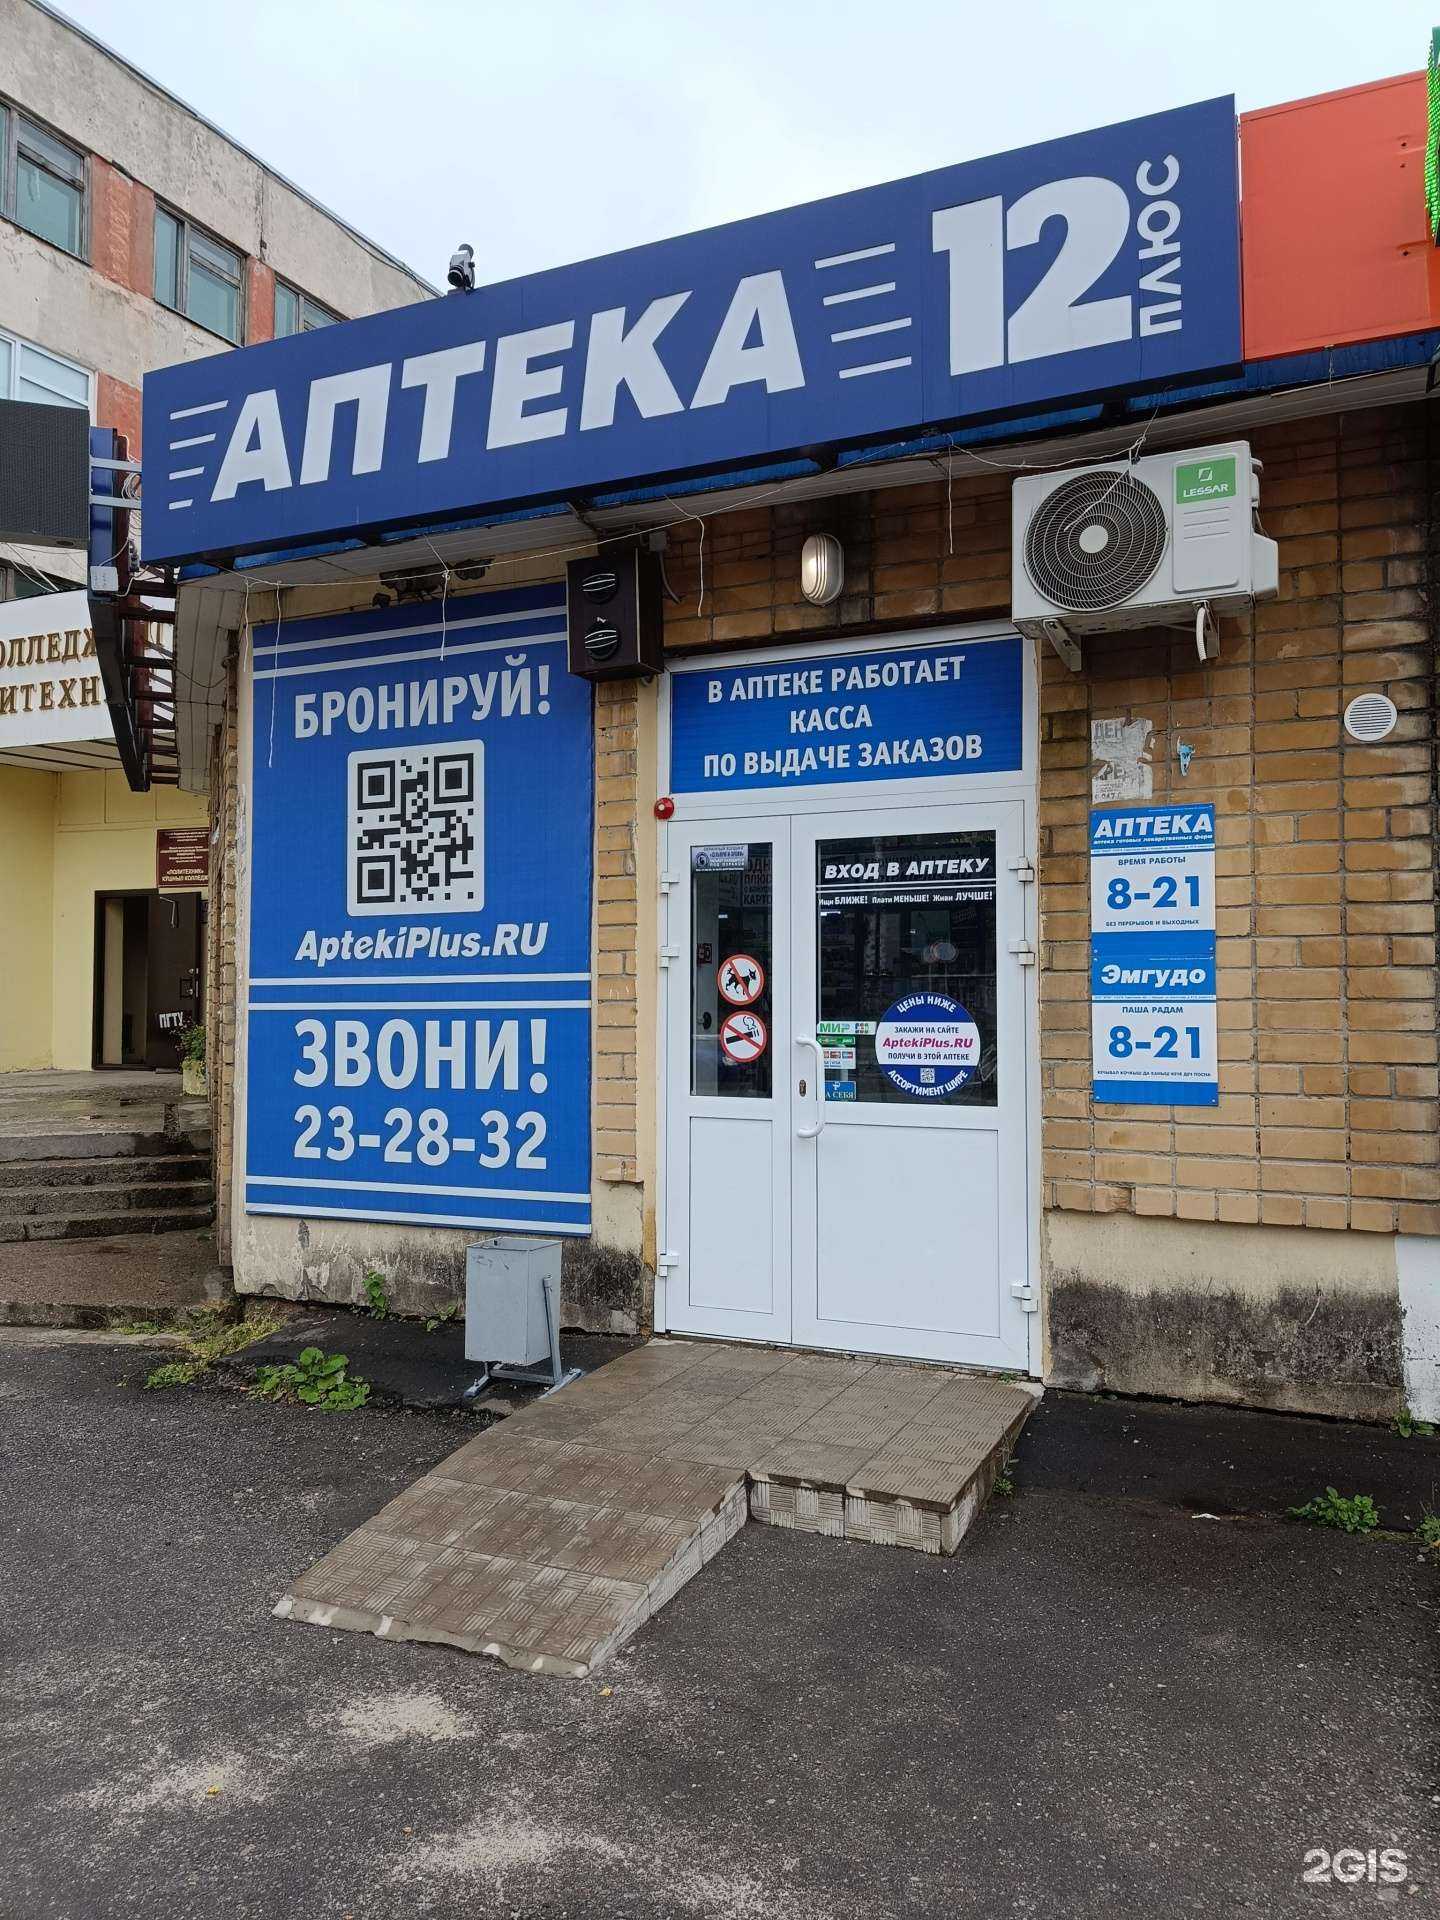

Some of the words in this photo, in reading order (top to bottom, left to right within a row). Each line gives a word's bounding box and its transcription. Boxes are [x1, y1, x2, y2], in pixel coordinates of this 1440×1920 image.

[210, 269, 806, 503] АПТЕКА
[931, 175, 1133, 377] 12
[1183, 482, 1229, 498] LESSAR
[707, 679, 723, 703] В
[730, 669, 823, 702] АПТЕКЕ
[830, 655, 967, 693] РАБОТАЕТ
[293, 652, 551, 739] БРОНИРУЙ!
[790, 704, 874, 734] КАССА
[703, 753, 736, 778] ПО
[744, 744, 850, 776] ВЫДАЧЕ
[857, 734, 983, 767] ЗАКАЗОВ
[1093, 813, 1213, 838] АПТЕКА
[824, 862, 880, 880] ВХОД
[886, 861, 900, 877] В
[905, 857, 990, 876] АПТЕКУ
[1118, 858, 1146, 866] ВРЕМЯ
[1149, 856, 1187, 865] РАБОТЫ
[818, 898, 834, 906] Ищи
[834, 895, 868, 905] БЛИЖЕ!
[872, 896, 892, 904] Плати
[893, 894, 930, 903] МЕНЬШЕ!
[955, 891, 993, 902] ЛУЧШЕ!
[1106, 875, 1200, 910] 8-21
[293, 921, 549, 968] AptekiPlus.RU
[1100, 964, 1206, 988] Эмгудо
[896, 995, 925, 1013] ЦЕНЫ
[927, 995, 957, 1013] НИЖЕ
[1151, 1006, 1184, 1014] РАДАМ
[819, 1022, 850, 1033] МИР
[894, 1025, 924, 1034] ЗАКАЖИ
[925, 1026, 936, 1034] НА
[937, 1024, 960, 1034] САЙТЕ
[882, 1037, 974, 1050] AptekiPlus.RU
[1108, 1025, 1201, 1059] 8-21
[293, 1017, 549, 1095] ЗВОНИ!
[888, 1052, 916, 1060] ПОЛУЧИ
[923, 1051, 942, 1060] ЭТОЙ
[943, 1053, 970, 1061] АПТЕКЕ
[887, 1069, 945, 1097] АССОРТИМЕНТ
[944, 1069, 969, 1091] ШИРЕ
[293, 1104, 549, 1171] 23-28-32
